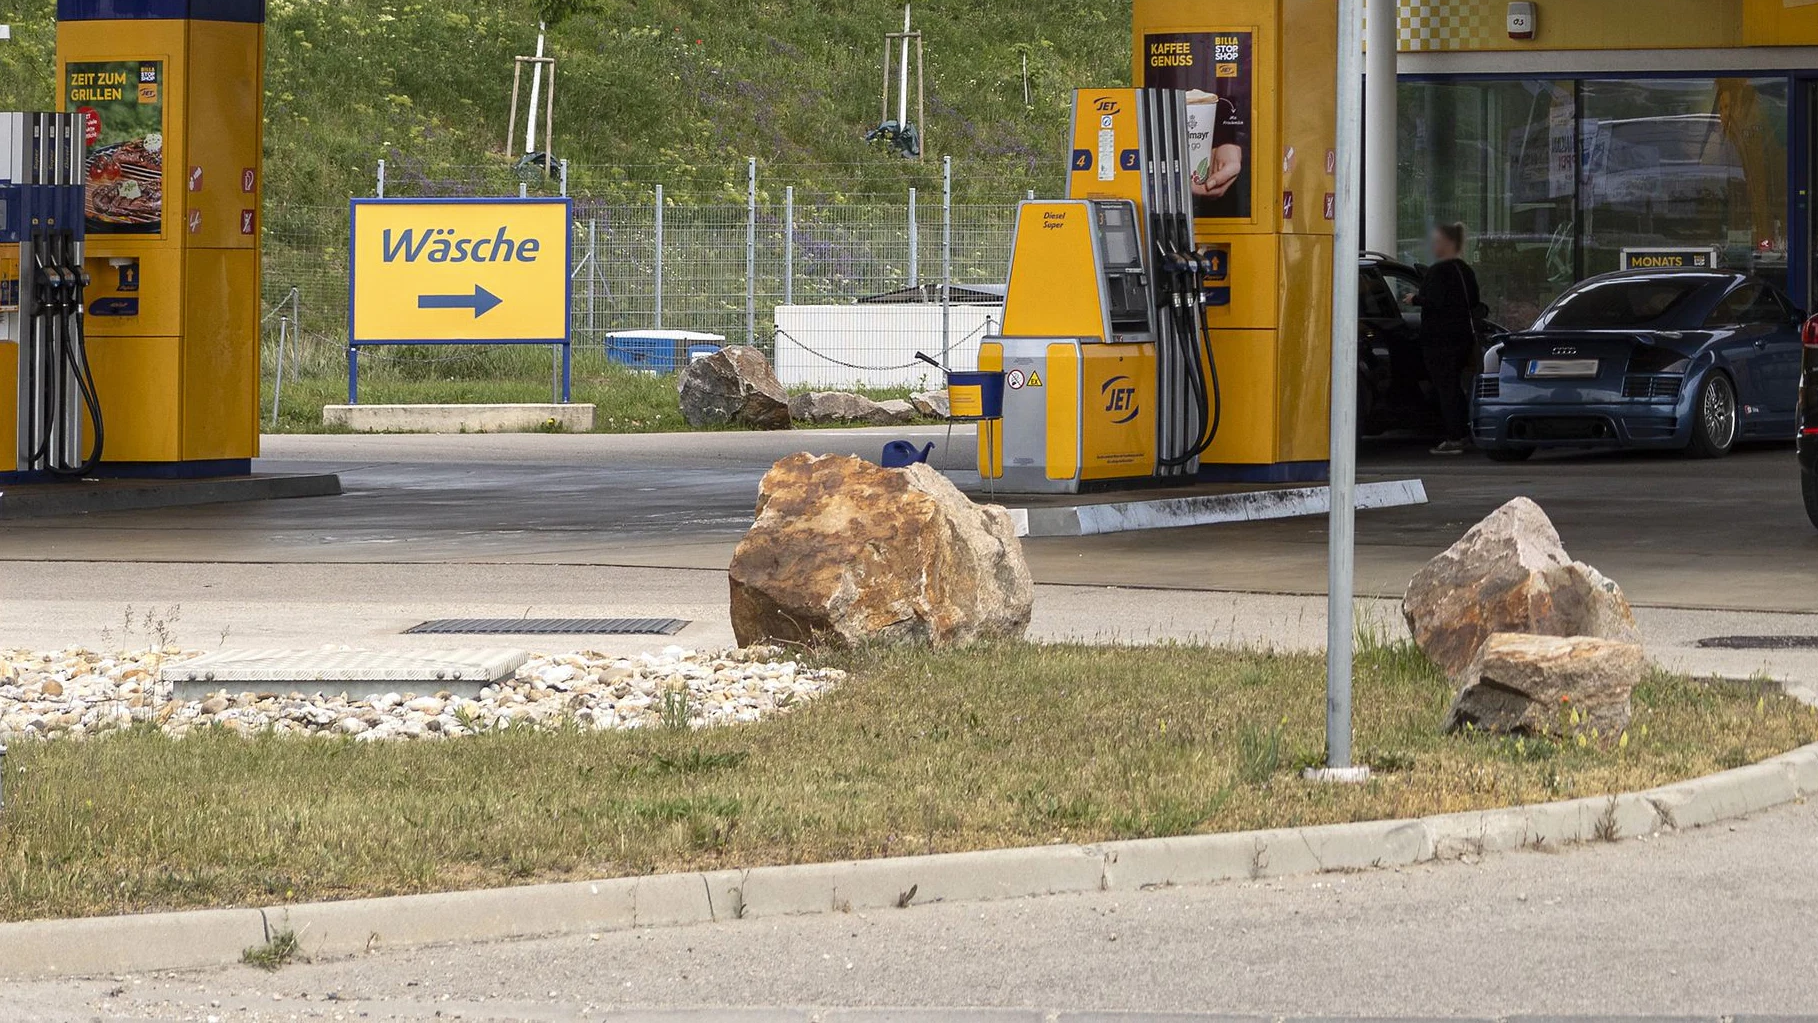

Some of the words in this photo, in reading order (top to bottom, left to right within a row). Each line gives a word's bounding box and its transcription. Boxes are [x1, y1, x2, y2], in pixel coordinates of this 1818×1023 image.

[1214, 37, 1239, 45] BILLA
[1151, 43, 1191, 55] KAFFEE
[1215, 45, 1239, 53] STOP
[1151, 55, 1193, 67] GENUSS
[1215, 52, 1239, 61] SHOP
[71, 73, 95, 86] ZEIT
[97, 71, 126, 85] ZUM
[70, 88, 122, 101] GRILLEN
[1097, 101, 1118, 111] JET
[1076, 154, 1086, 167] 4
[1126, 154, 1135, 166] 3
[1043, 221, 1064, 230] Super
[383, 226, 540, 263] Wäsche
[1631, 256, 1683, 267] MONATS
[1105, 388, 1136, 412] JET
